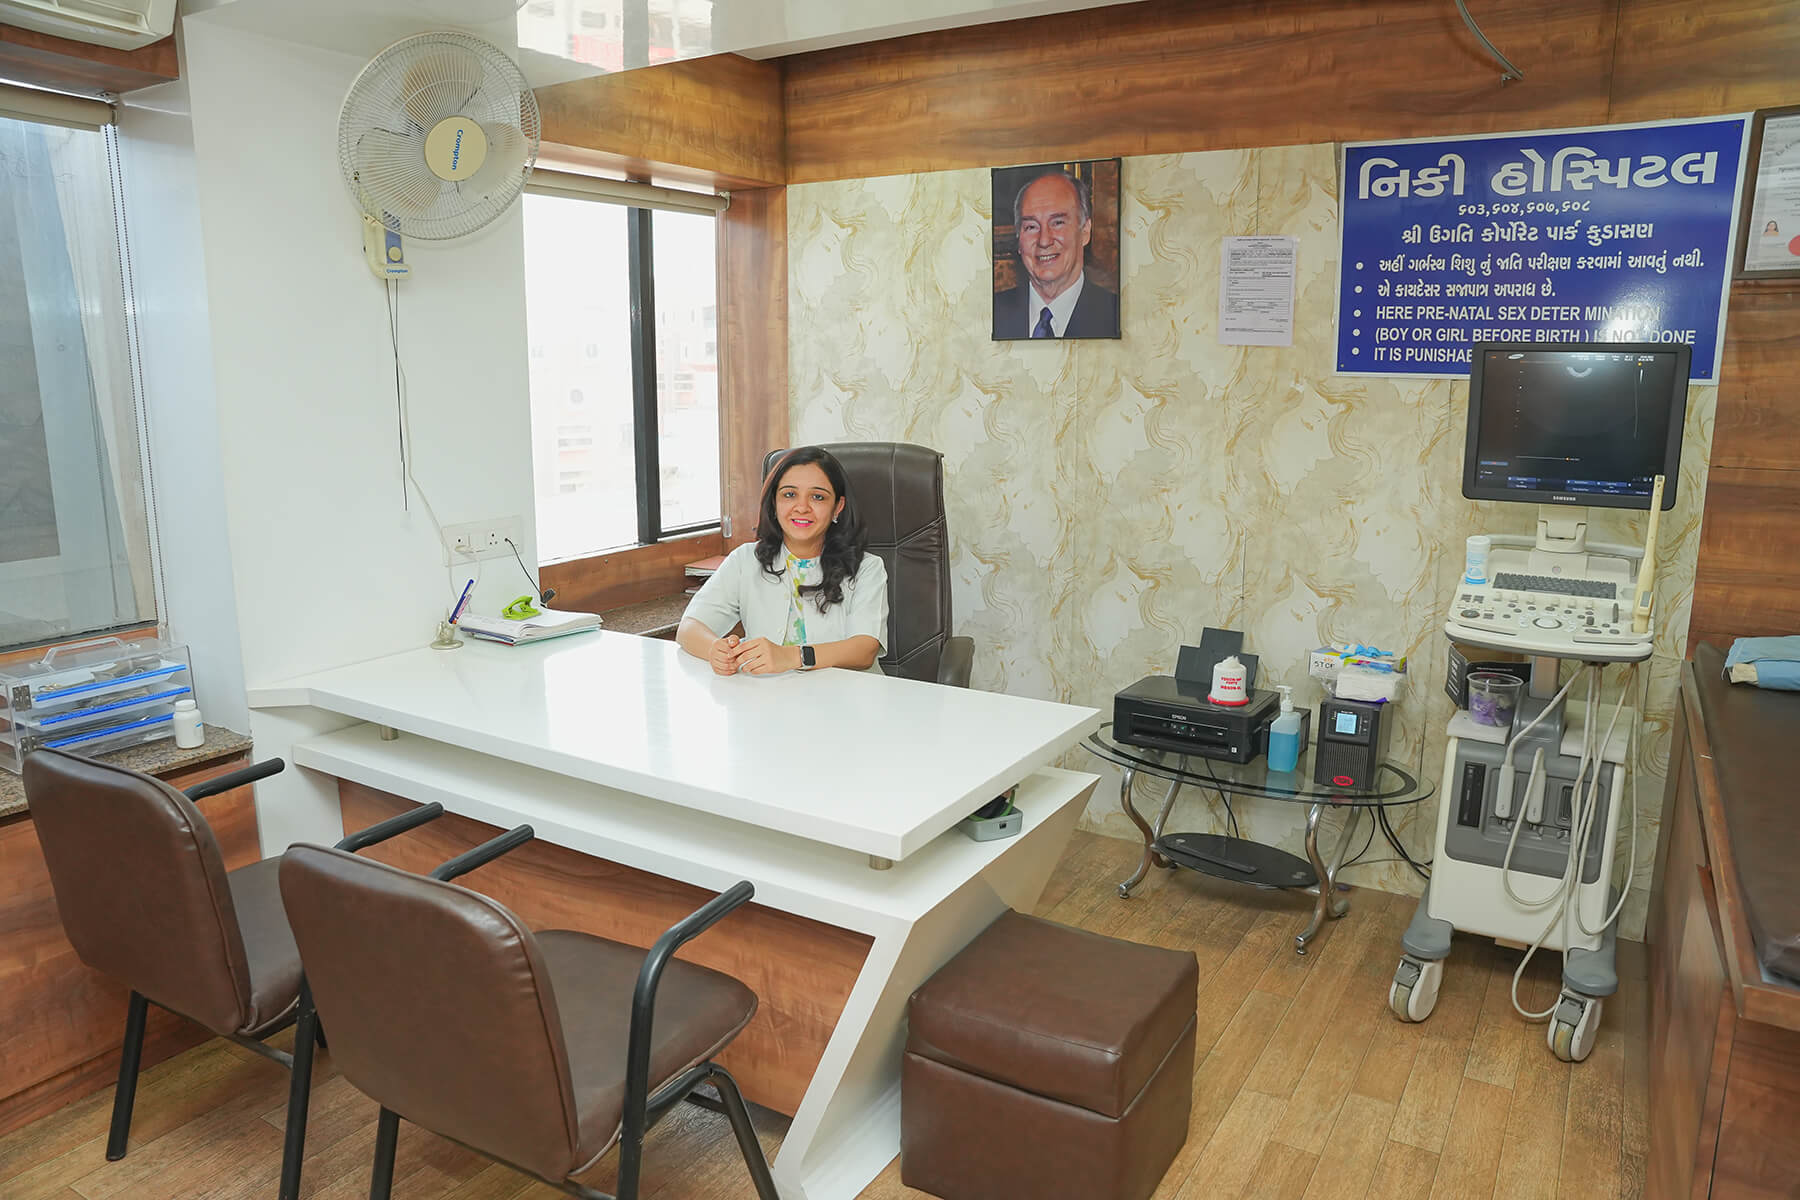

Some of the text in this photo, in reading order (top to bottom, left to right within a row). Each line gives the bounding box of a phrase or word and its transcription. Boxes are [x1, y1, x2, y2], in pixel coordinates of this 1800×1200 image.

[451, 129, 464, 170] Crompton
[1358, 146, 1719, 200] નિકી હોસ્પિટલ
[1401, 224, 1422, 244] શ્રી
[1429, 223, 1474, 244] ઉગતિ
[1546, 219, 1582, 241] પાર્ક
[1586, 222, 1654, 247] કુડાસણ
[1379, 248, 1705, 277] અહીં ગર્ભસ્થ શિશુ નું જાતિ પરીક્ષણ કરવામાં આવતું નથી.
[1377, 278, 1556, 297] એ કાયદેસર સજાપાત્ર અપરાધ છે.
[1376, 305, 1413, 320] HERE
[1417, 305, 1494, 321] PRE-NATAL
[1497, 305, 1527, 321] SEX
[1530, 306, 1580, 321] DETER
[1375, 327, 1409, 344] (BOY
[1412, 328, 1432, 341] OR
[1436, 328, 1468, 342] GIRL
[1472, 328, 1531, 342] BEFORE
[1535, 329, 1580, 343] BIRTH
[1650, 329, 1697, 344] DONE
[1374, 347, 1387, 361] IT
[1389, 347, 1402, 362] IS
[1171, 713, 1187, 721] EPSON
